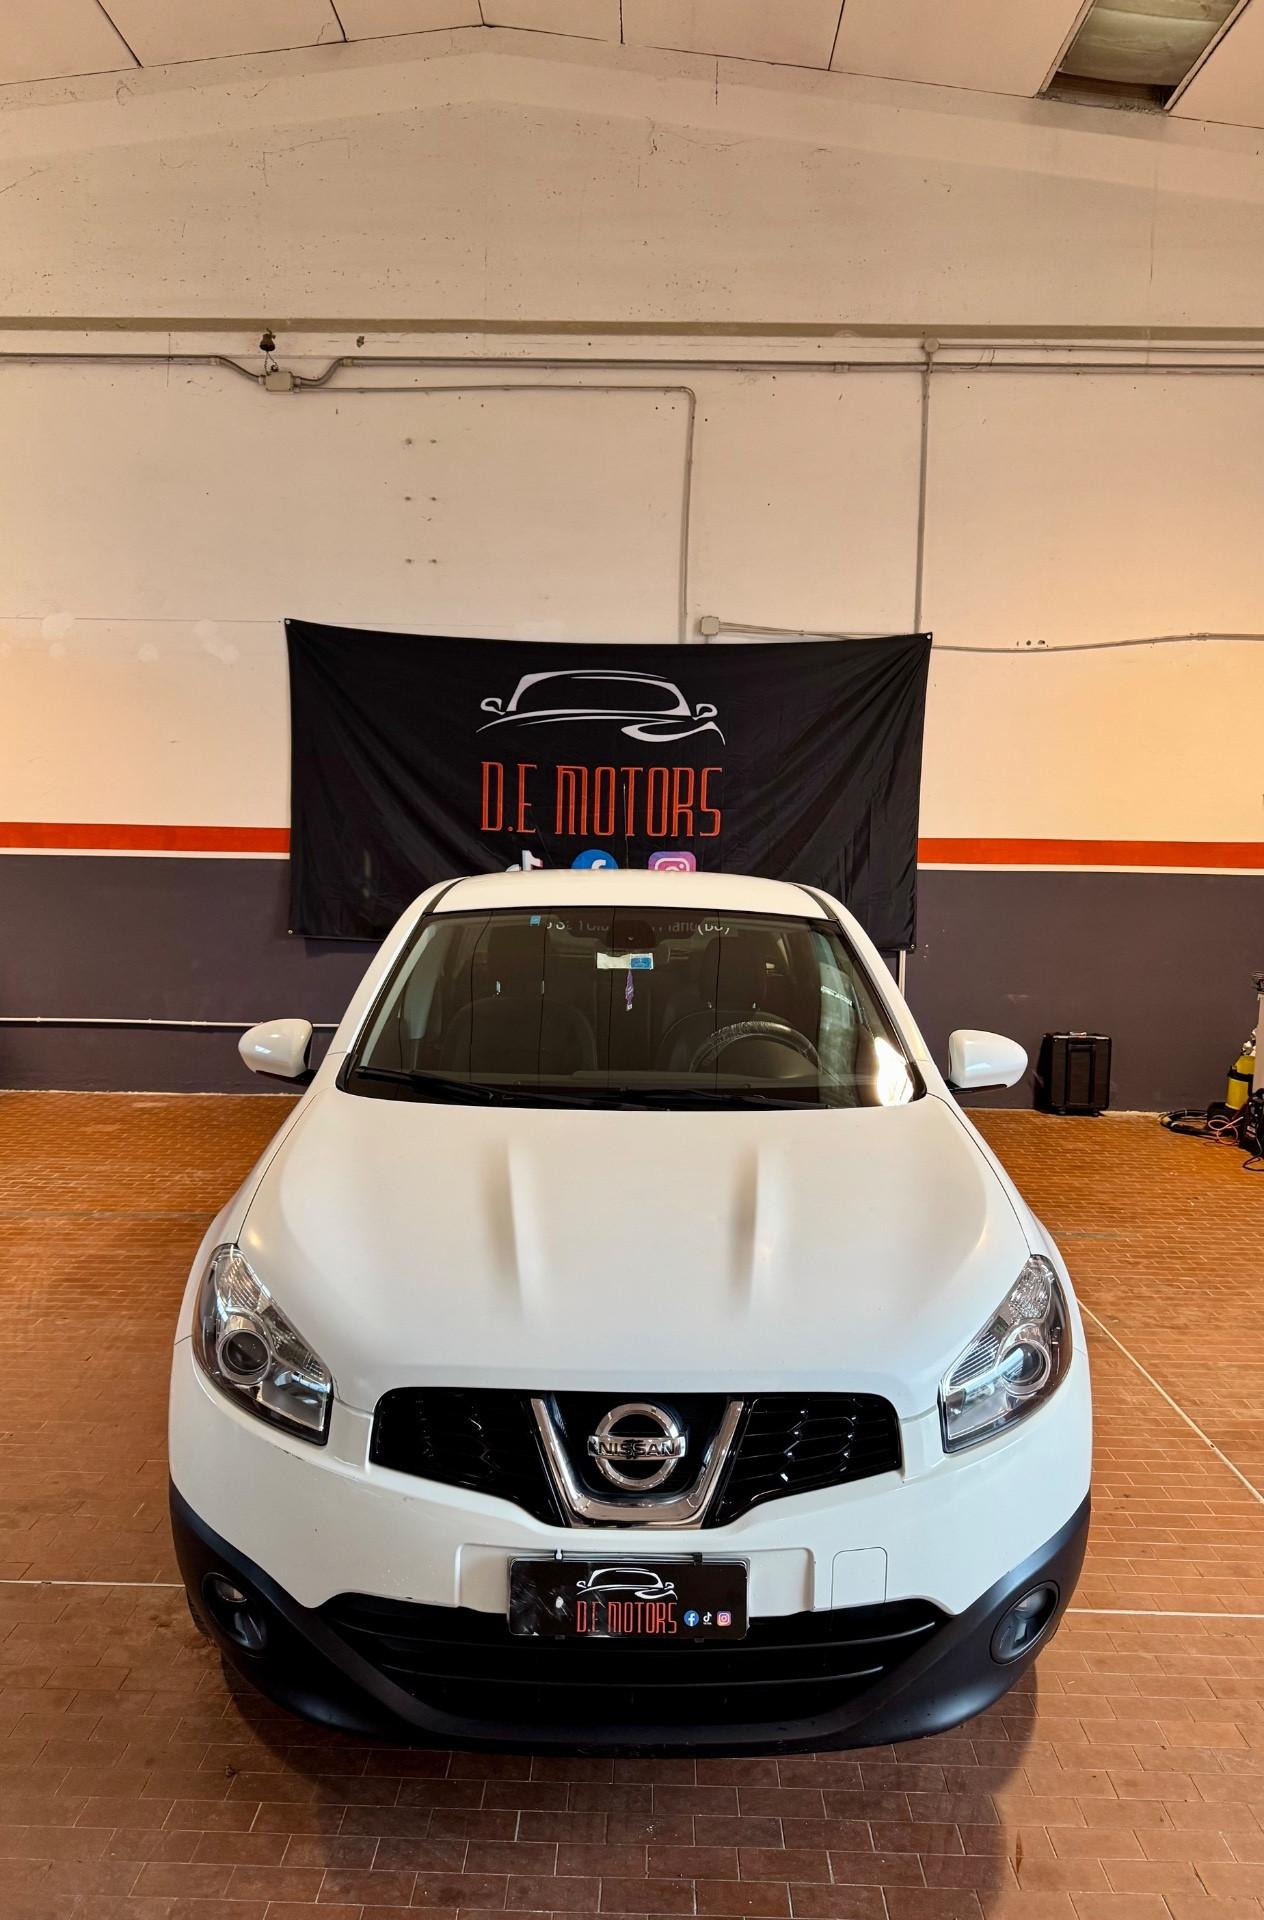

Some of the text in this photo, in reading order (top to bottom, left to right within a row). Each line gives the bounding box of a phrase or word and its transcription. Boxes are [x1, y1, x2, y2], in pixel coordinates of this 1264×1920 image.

[480, 761, 723, 837] D.E MOTORS
[598, 1440, 675, 1457] NISSAN
[576, 1600, 678, 1634] D.E MOTORS
